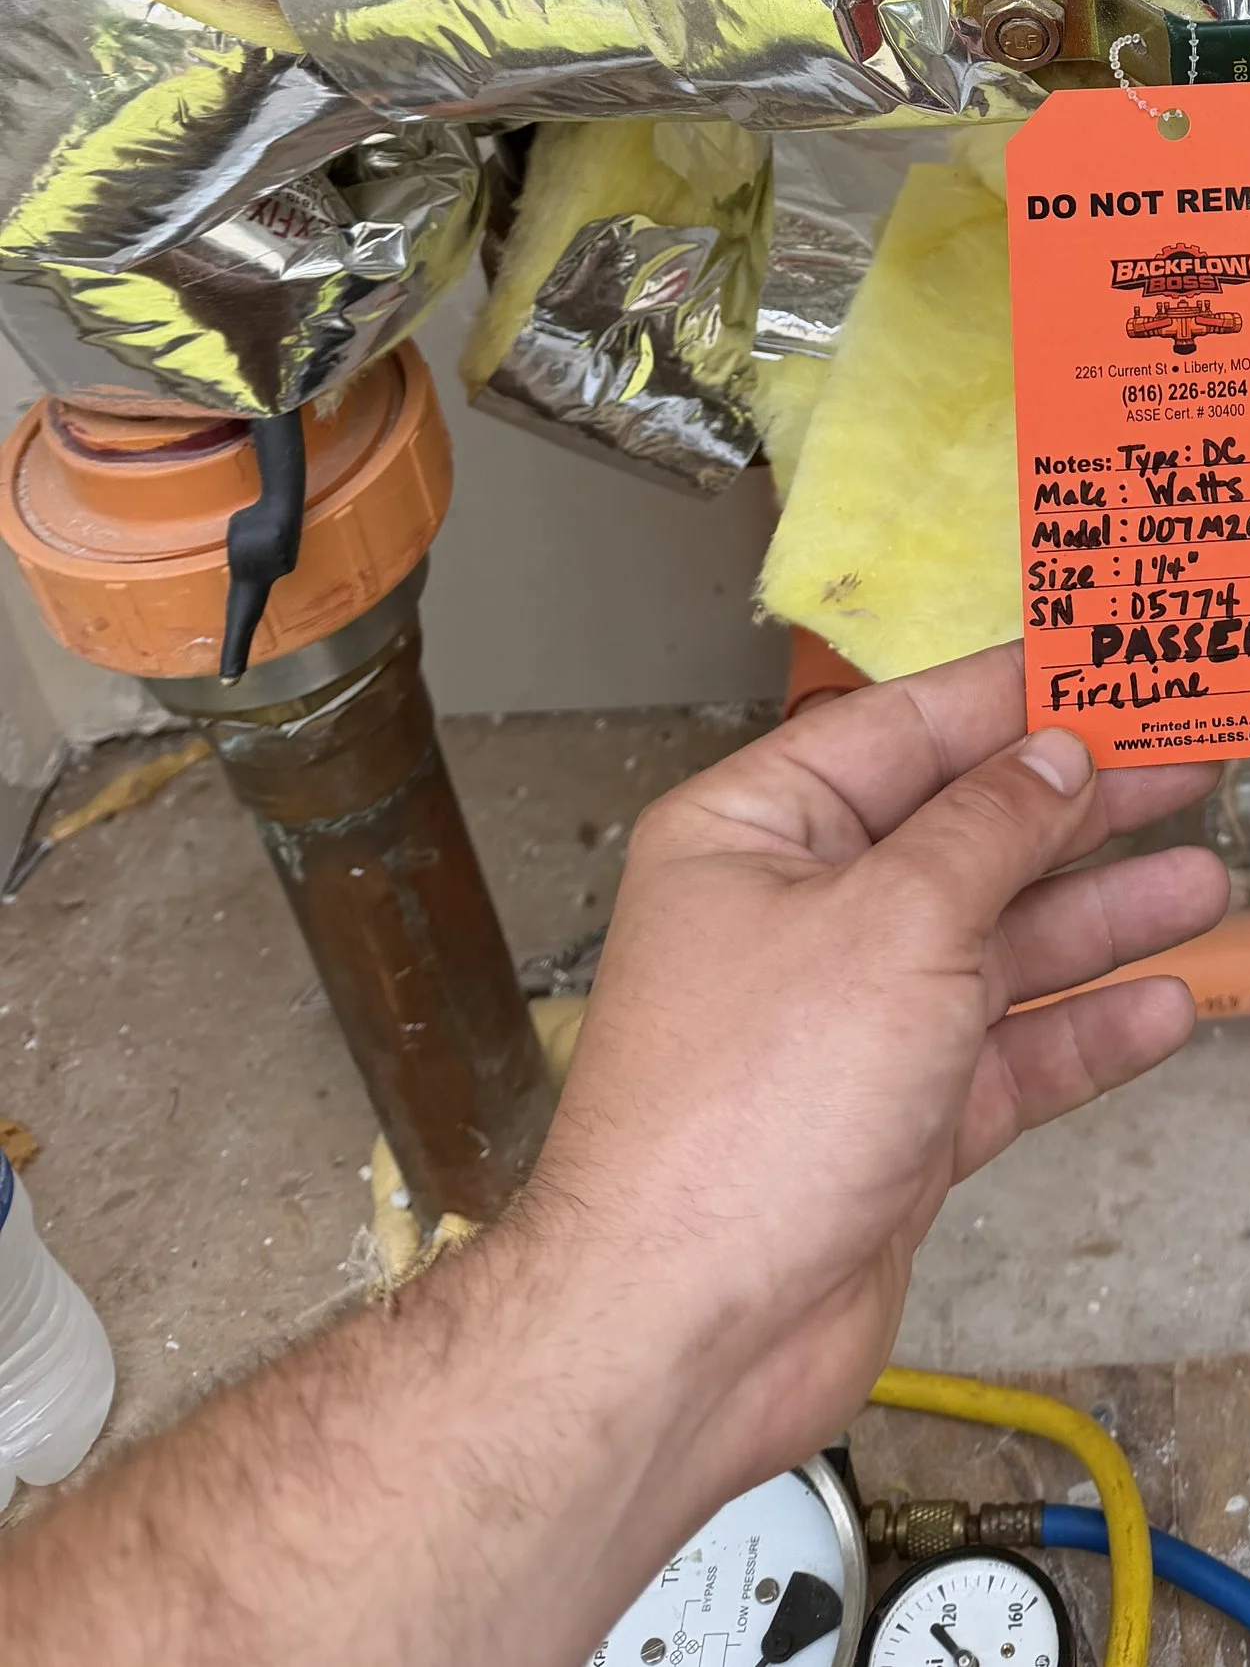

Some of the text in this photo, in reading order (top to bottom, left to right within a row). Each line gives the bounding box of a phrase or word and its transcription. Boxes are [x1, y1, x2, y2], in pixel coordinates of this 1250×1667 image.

[1233, 57, 1249, 82] 163
[1027, 194, 1077, 221] DO
[1090, 190, 1164, 218] NOT
[1114, 255, 1249, 282] BACKFLOW
[1149, 277, 1216, 292] BOSS
[1075, 365, 1103, 379] 2261
[1108, 363, 1152, 377] Current
[1156, 362, 1168, 375] St
[1184, 360, 1227, 375] Liberty,
[1121, 379, 1248, 408] (816) 226-8264
[1126, 409, 1161, 423] ASSE
[1164, 407, 1194, 421] Cert.
[1207, 403, 1245, 418] 30400
[1034, 455, 1112, 476] Notes:
[1202, 437, 1246, 467] DC
[1146, 471, 1245, 506] Watts
[1030, 593, 1074, 628] SN
[1141, 720, 1191, 734] Printed
[1194, 719, 1208, 731] in
[701, 1565, 719, 1613] BYPASS
[737, 1534, 761, 1634] LOW PRESSURE
[940, 1603, 957, 1628] 120
[1008, 1602, 1024, 1631] 160
